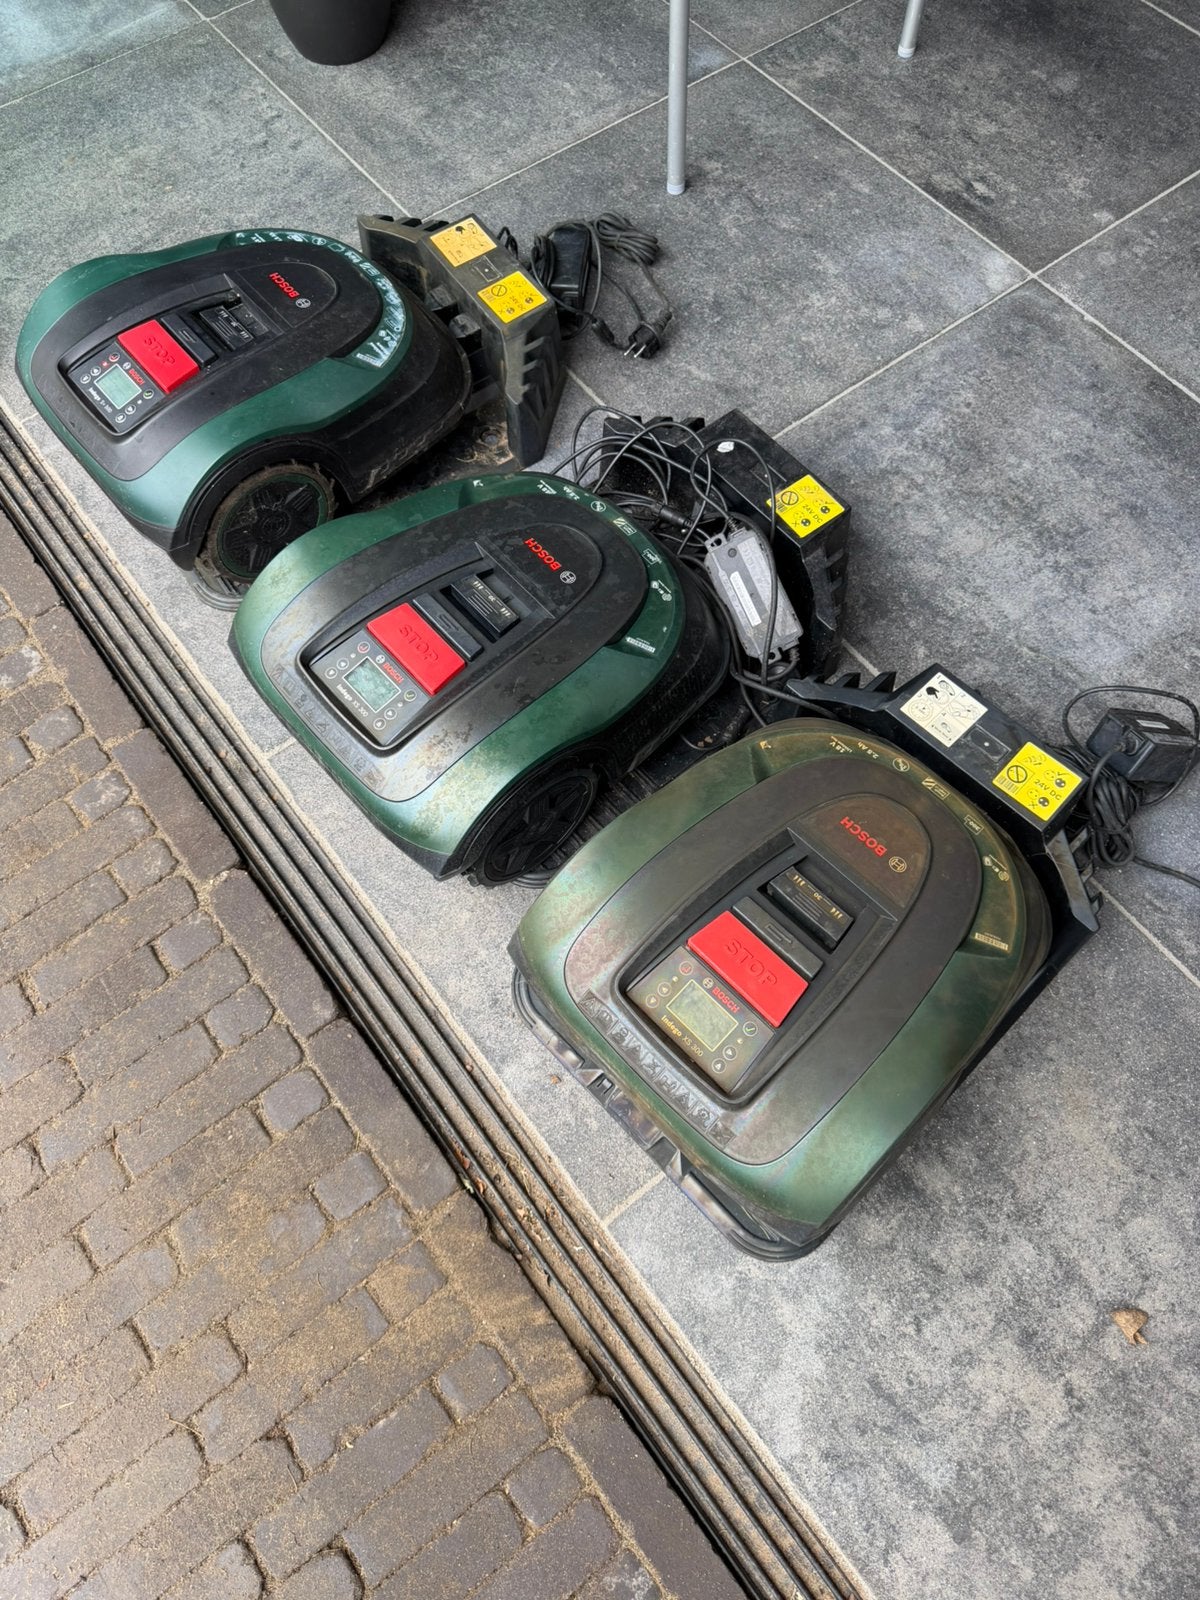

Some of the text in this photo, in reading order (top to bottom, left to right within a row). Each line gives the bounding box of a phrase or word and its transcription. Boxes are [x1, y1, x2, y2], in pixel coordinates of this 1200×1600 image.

[269, 272, 300, 298] BOSCH
[144, 335, 175, 364] STOP
[524, 538, 561, 571] BOSCH
[399, 624, 439, 661] STOP
[383, 662, 404, 684] BOSCH
[337, 684, 352, 701] Indego
[352, 699, 360, 708] XS
[1034, 779, 1062, 801] 24V DC
[840, 816, 887, 857] BOSCH
[725, 939, 777, 985] STOP
[712, 986, 740, 1013] BOSCH
[662, 1015, 703, 1057] Indego XS 300
